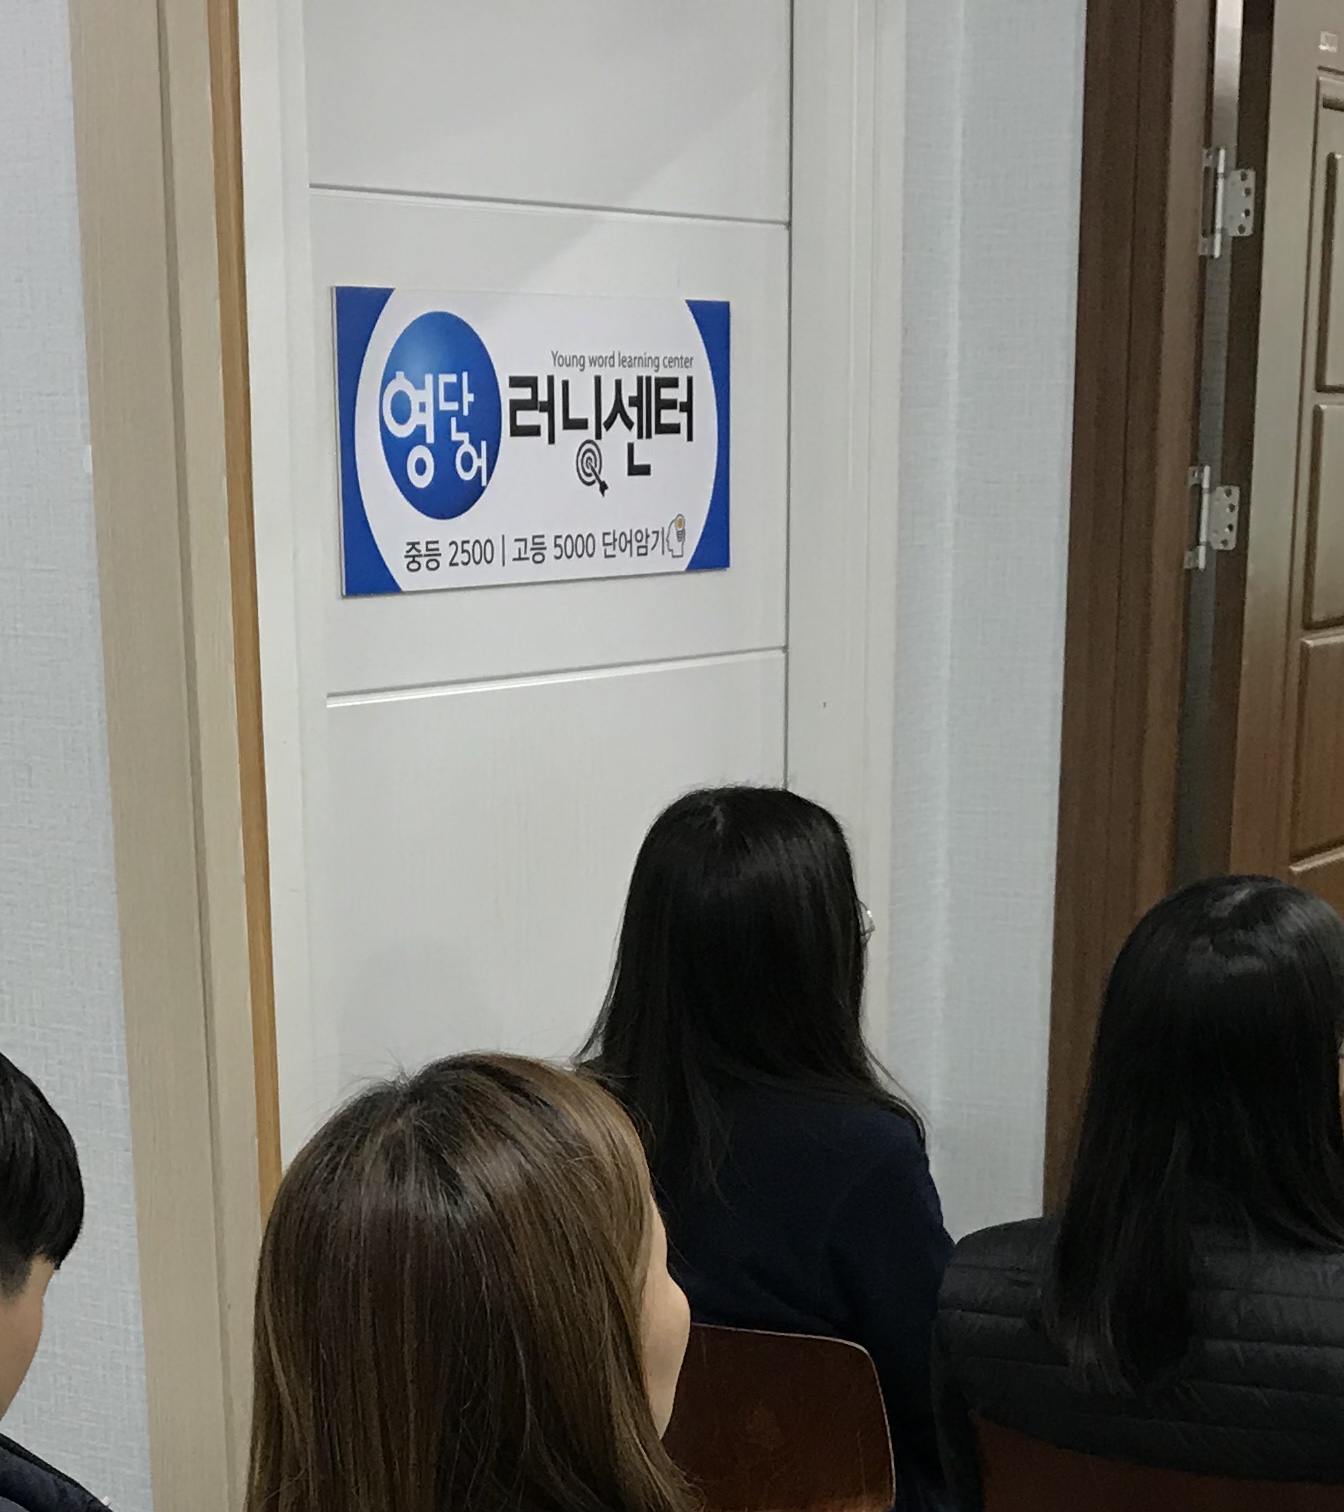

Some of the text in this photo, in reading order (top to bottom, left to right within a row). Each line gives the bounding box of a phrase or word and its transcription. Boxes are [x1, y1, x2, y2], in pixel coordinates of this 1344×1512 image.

[551, 350, 694, 373] Young word learning center
[508, 375, 694, 496] 러닝센터
[404, 527, 666, 573] 중등 2500 고등 5000 단어암기
